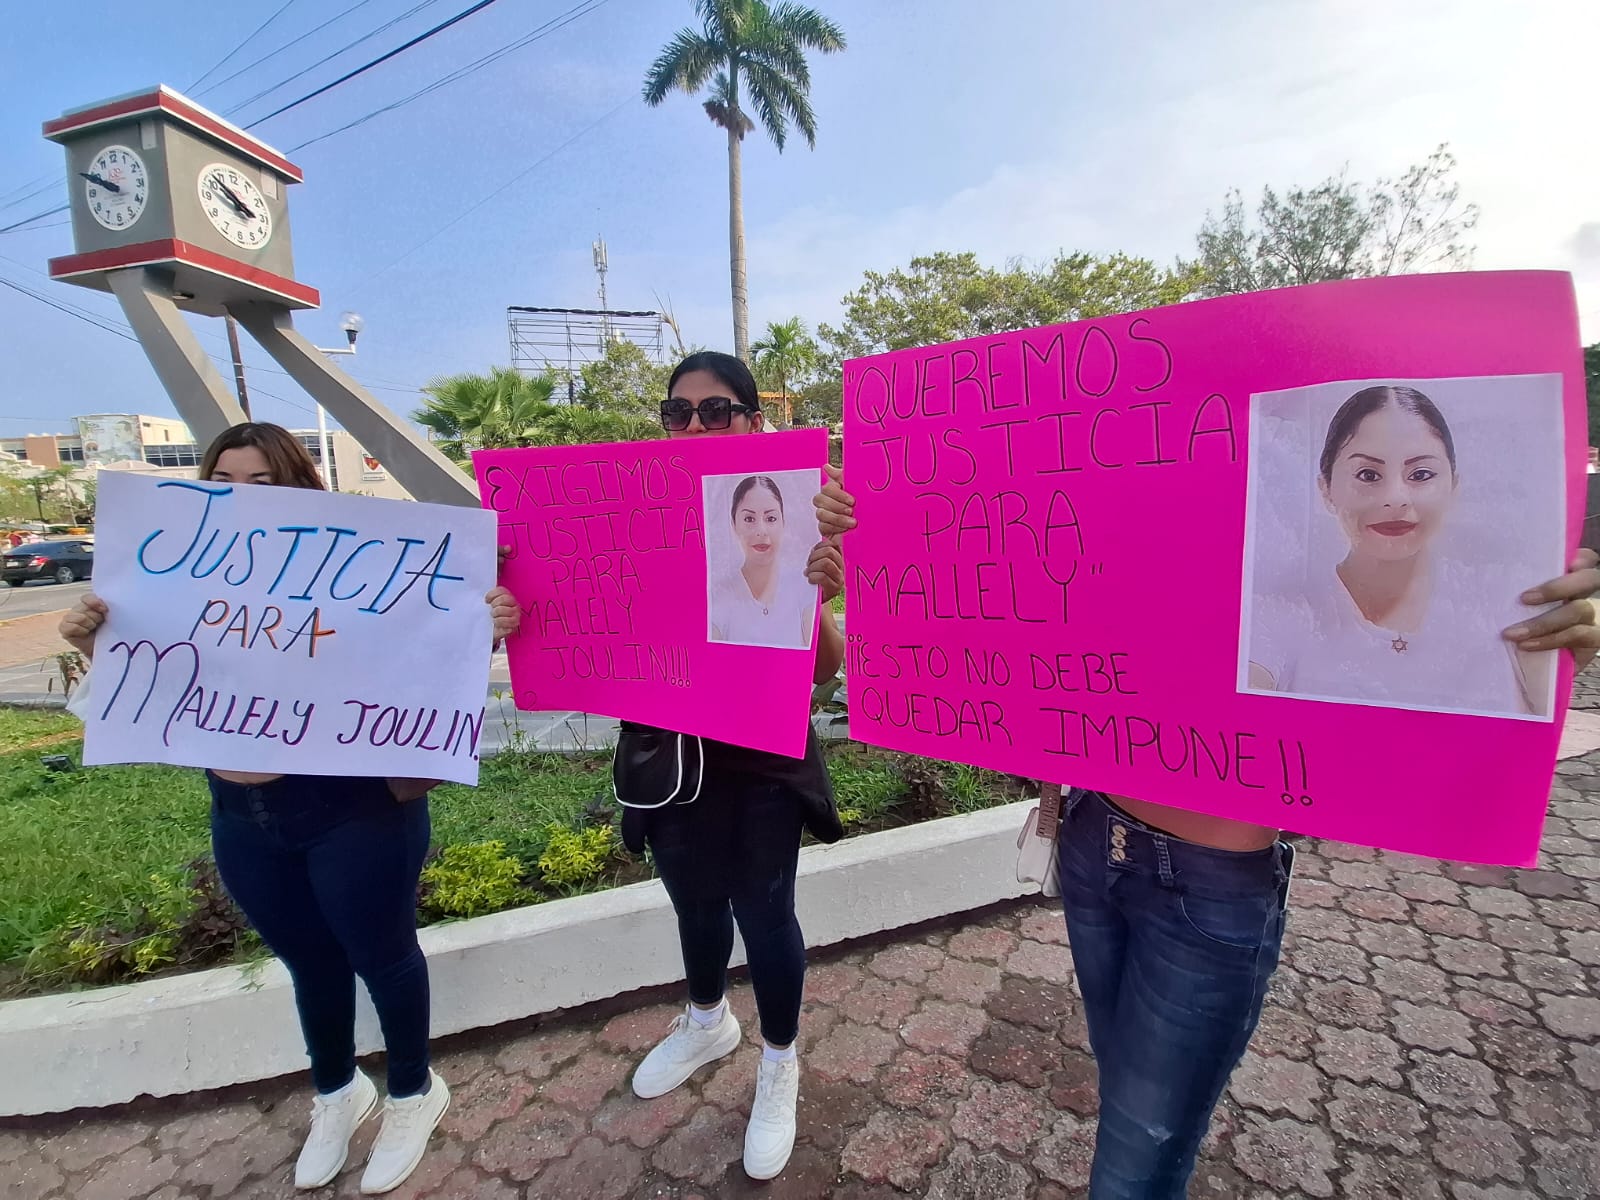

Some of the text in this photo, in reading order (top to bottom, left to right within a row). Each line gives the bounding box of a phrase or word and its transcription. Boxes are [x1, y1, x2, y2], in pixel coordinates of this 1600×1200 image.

[861, 393, 1238, 492] JUSTICIA
[485, 455, 696, 513] EXIGIMOS
[137, 482, 465, 614] JUSTICIA
[497, 506, 705, 560] JUSTICIA
[914, 489, 1085, 558] PARA
[547, 553, 643, 597] PARA
[189, 599, 336, 658] PARA
[516, 595, 636, 639] MALLELY
[101, 639, 315, 747] MALLELY
[540, 643, 692, 688] JOULIN!!!
[964, 647, 1012, 688] NO
[1029, 653, 1140, 695] DEBE
[861, 686, 1014, 746] QUEDAR
